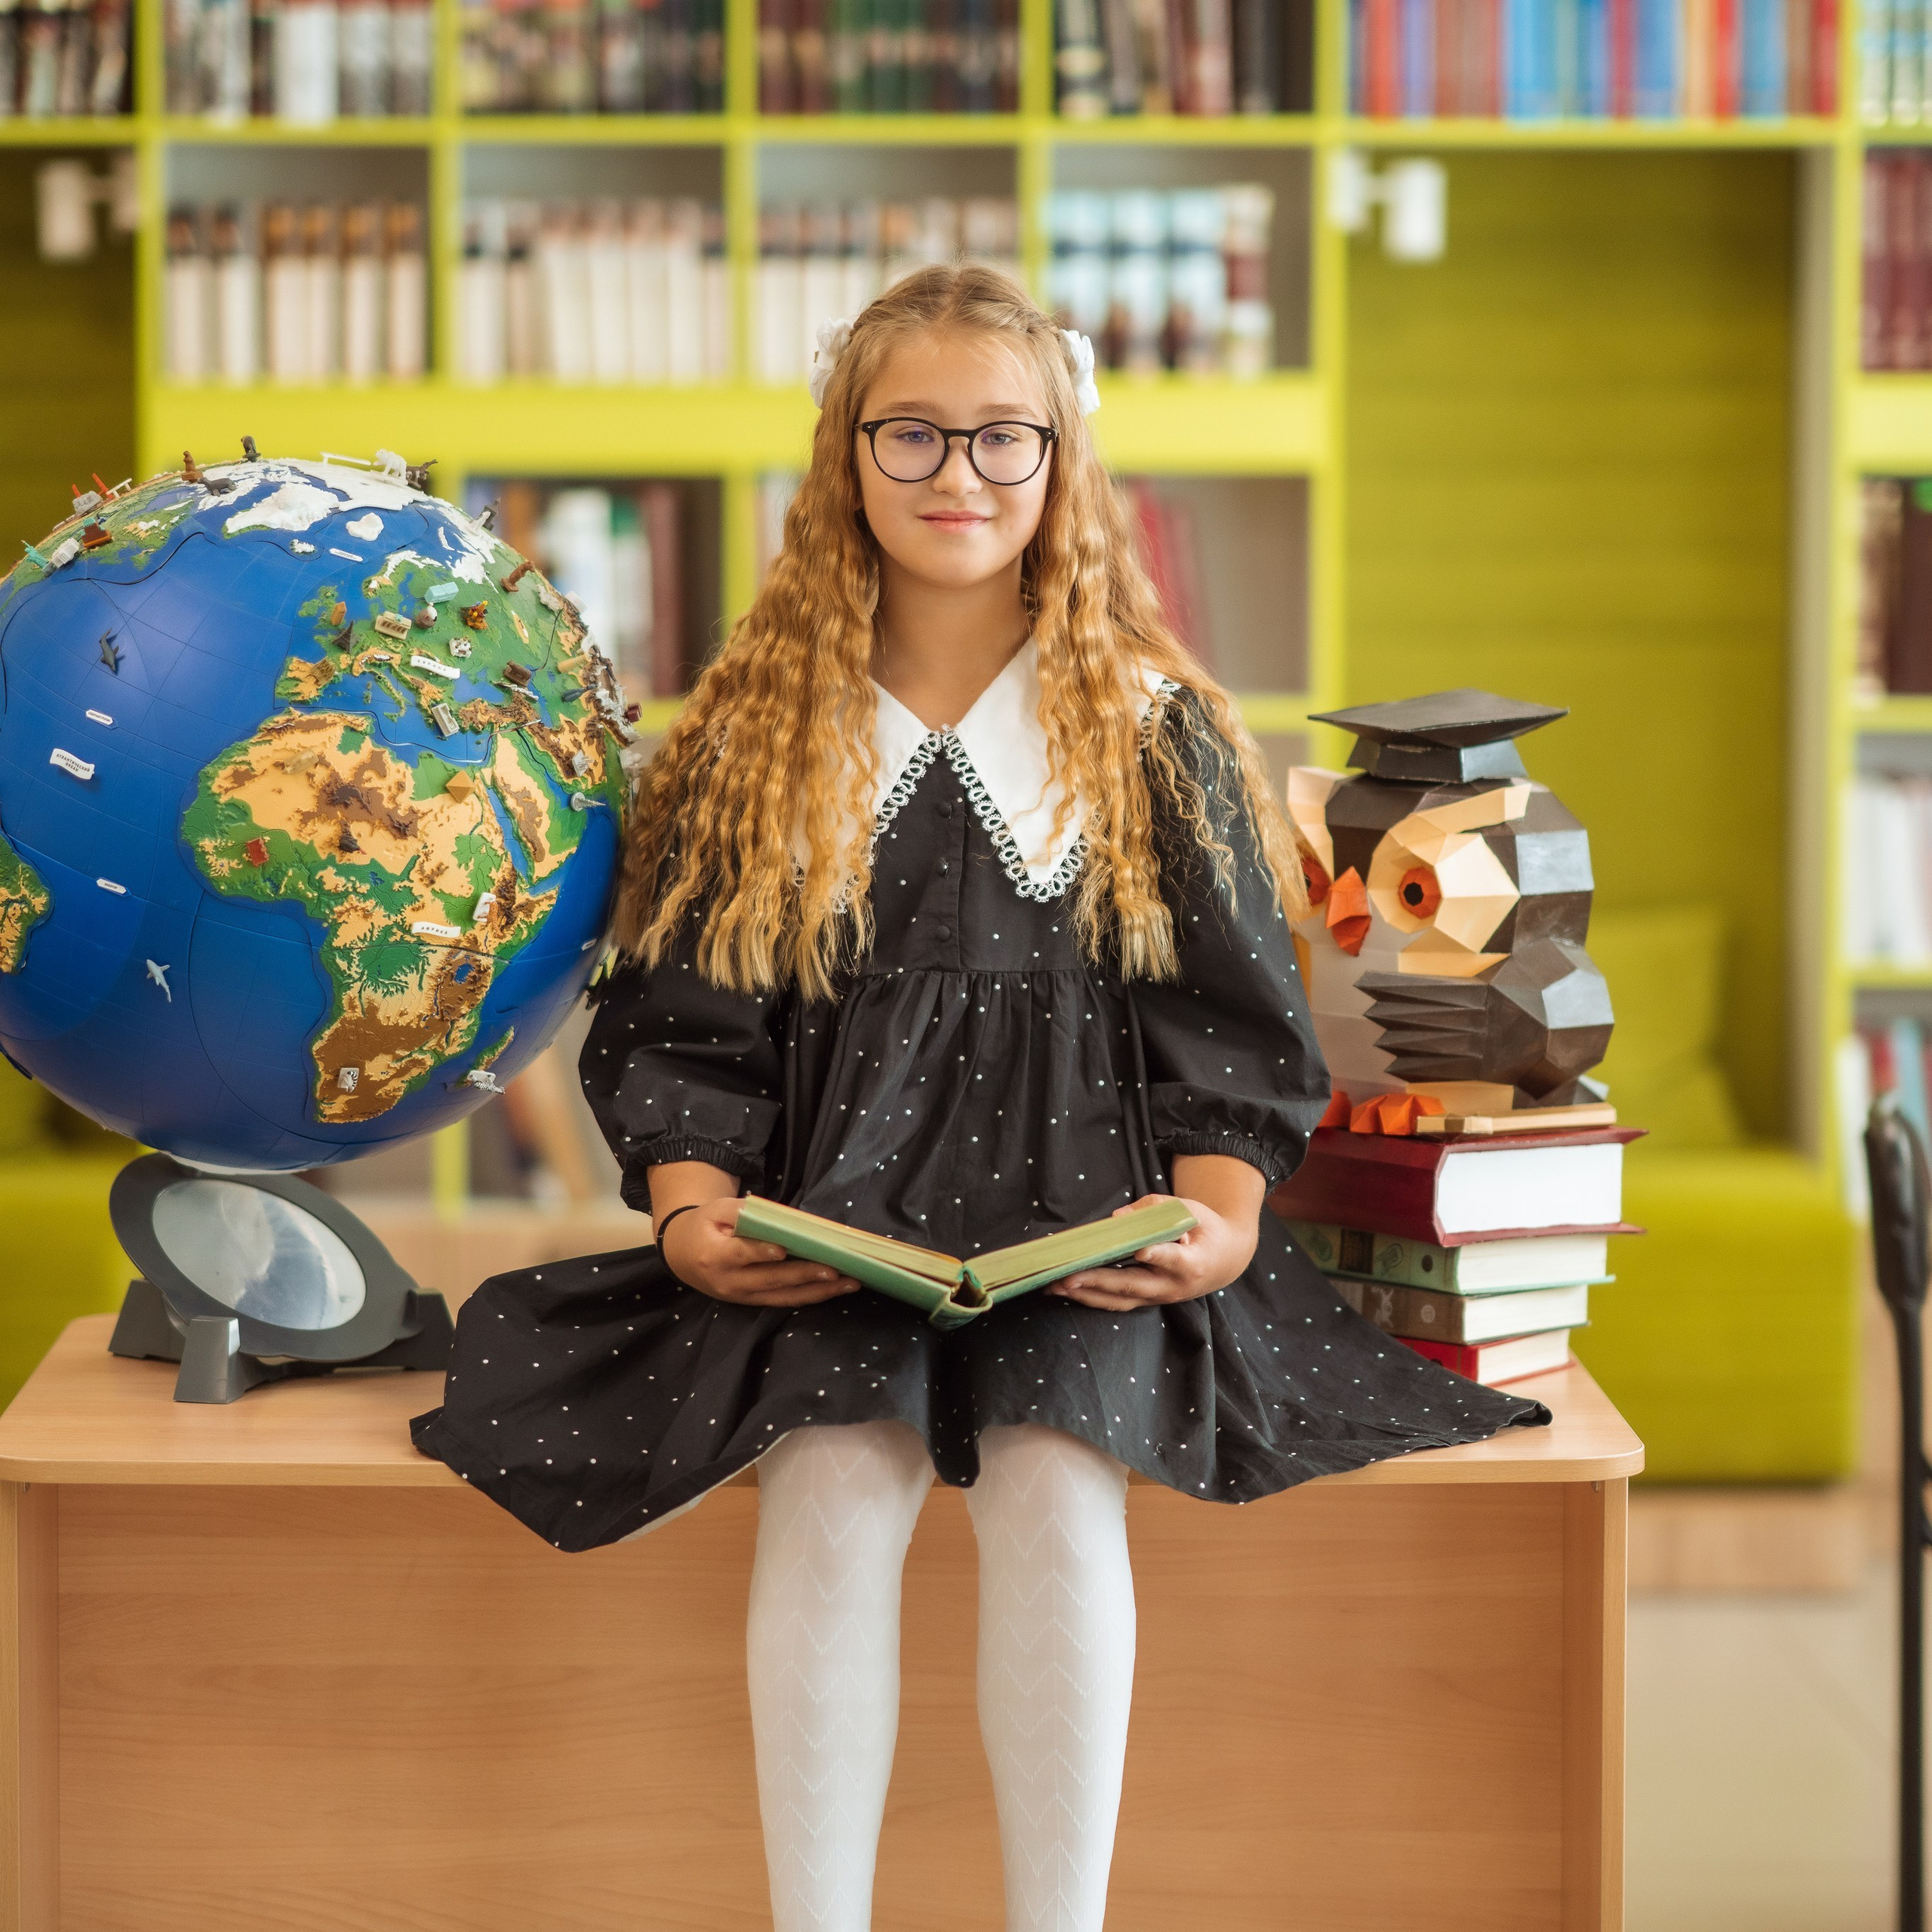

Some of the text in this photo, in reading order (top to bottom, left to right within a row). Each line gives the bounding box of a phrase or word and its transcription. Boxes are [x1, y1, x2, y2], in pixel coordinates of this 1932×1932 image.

[417, 660, 446, 672] ЕВРОПА
[56, 753, 91, 772] АТЛАНТИЧЕСКИЙ
[65, 762, 78, 772] ОКЕАН
[421, 926, 448, 935] АФРИКА
